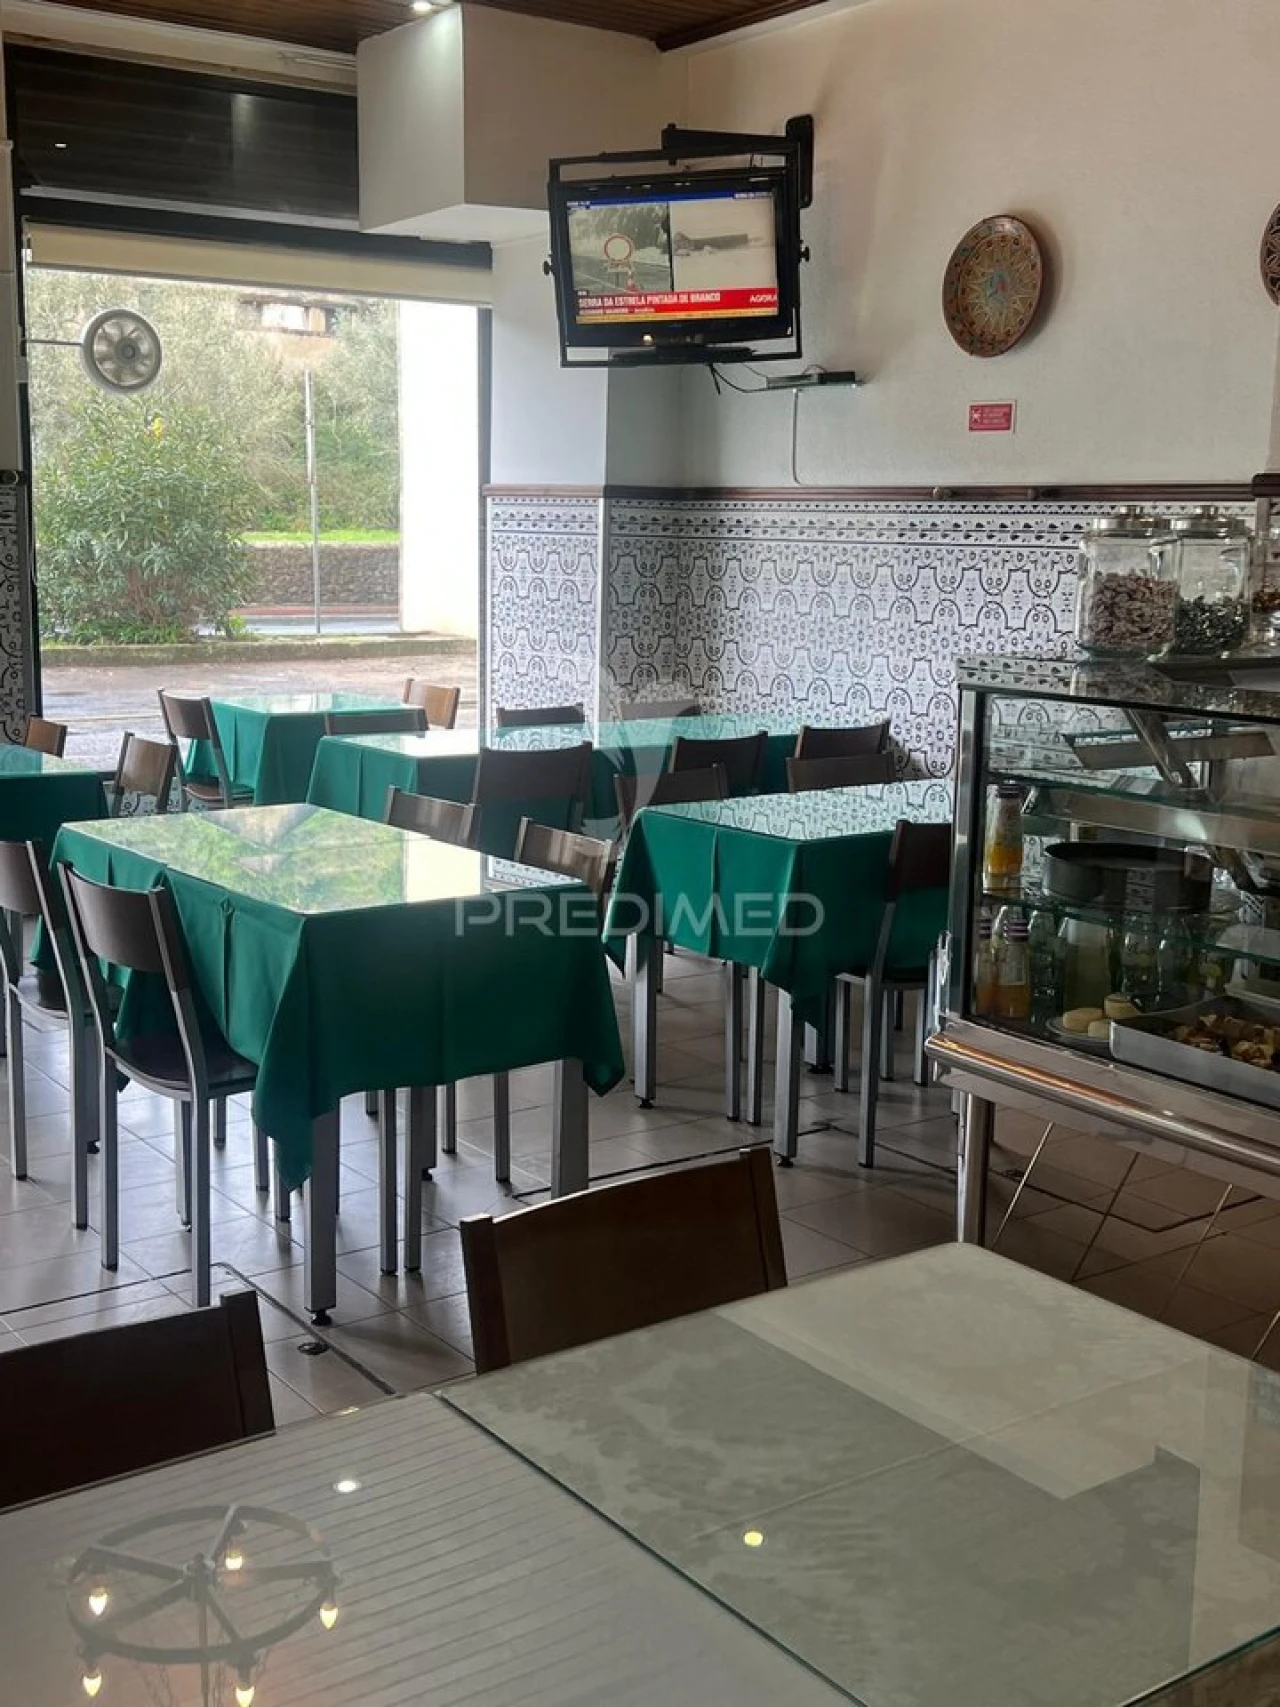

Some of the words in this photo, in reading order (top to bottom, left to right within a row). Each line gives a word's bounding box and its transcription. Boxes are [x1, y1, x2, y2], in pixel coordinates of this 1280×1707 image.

[614, 296, 646, 306] ESTRELA
[646, 294, 678, 304] PINTADA
[690, 292, 721, 303] BRANCO
